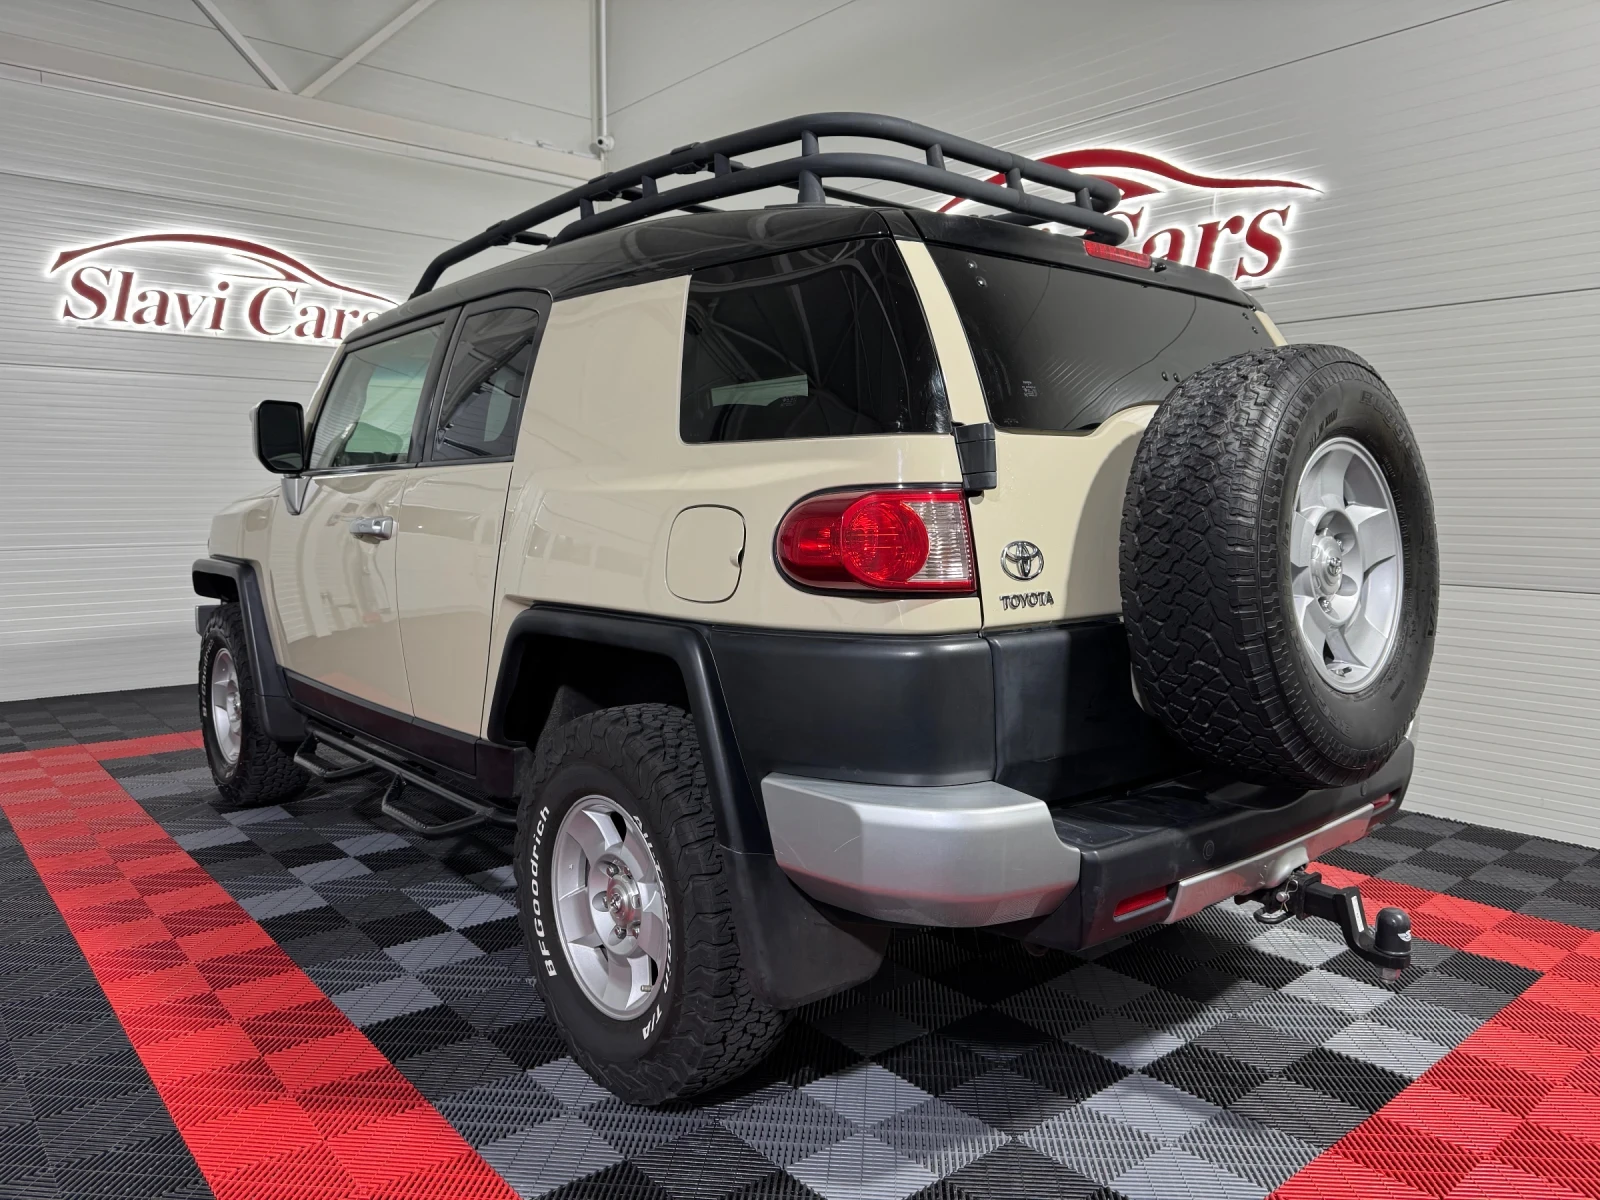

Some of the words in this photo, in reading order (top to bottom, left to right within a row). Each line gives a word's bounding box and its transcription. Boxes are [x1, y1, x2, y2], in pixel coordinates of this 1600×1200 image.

[1085, 203, 1291, 282] ars
[62, 266, 230, 332] Slavi
[999, 591, 1054, 611] TOYOTA
[531, 805, 557, 977] BFGoodrich
[642, 1004, 662, 1040] T/A
